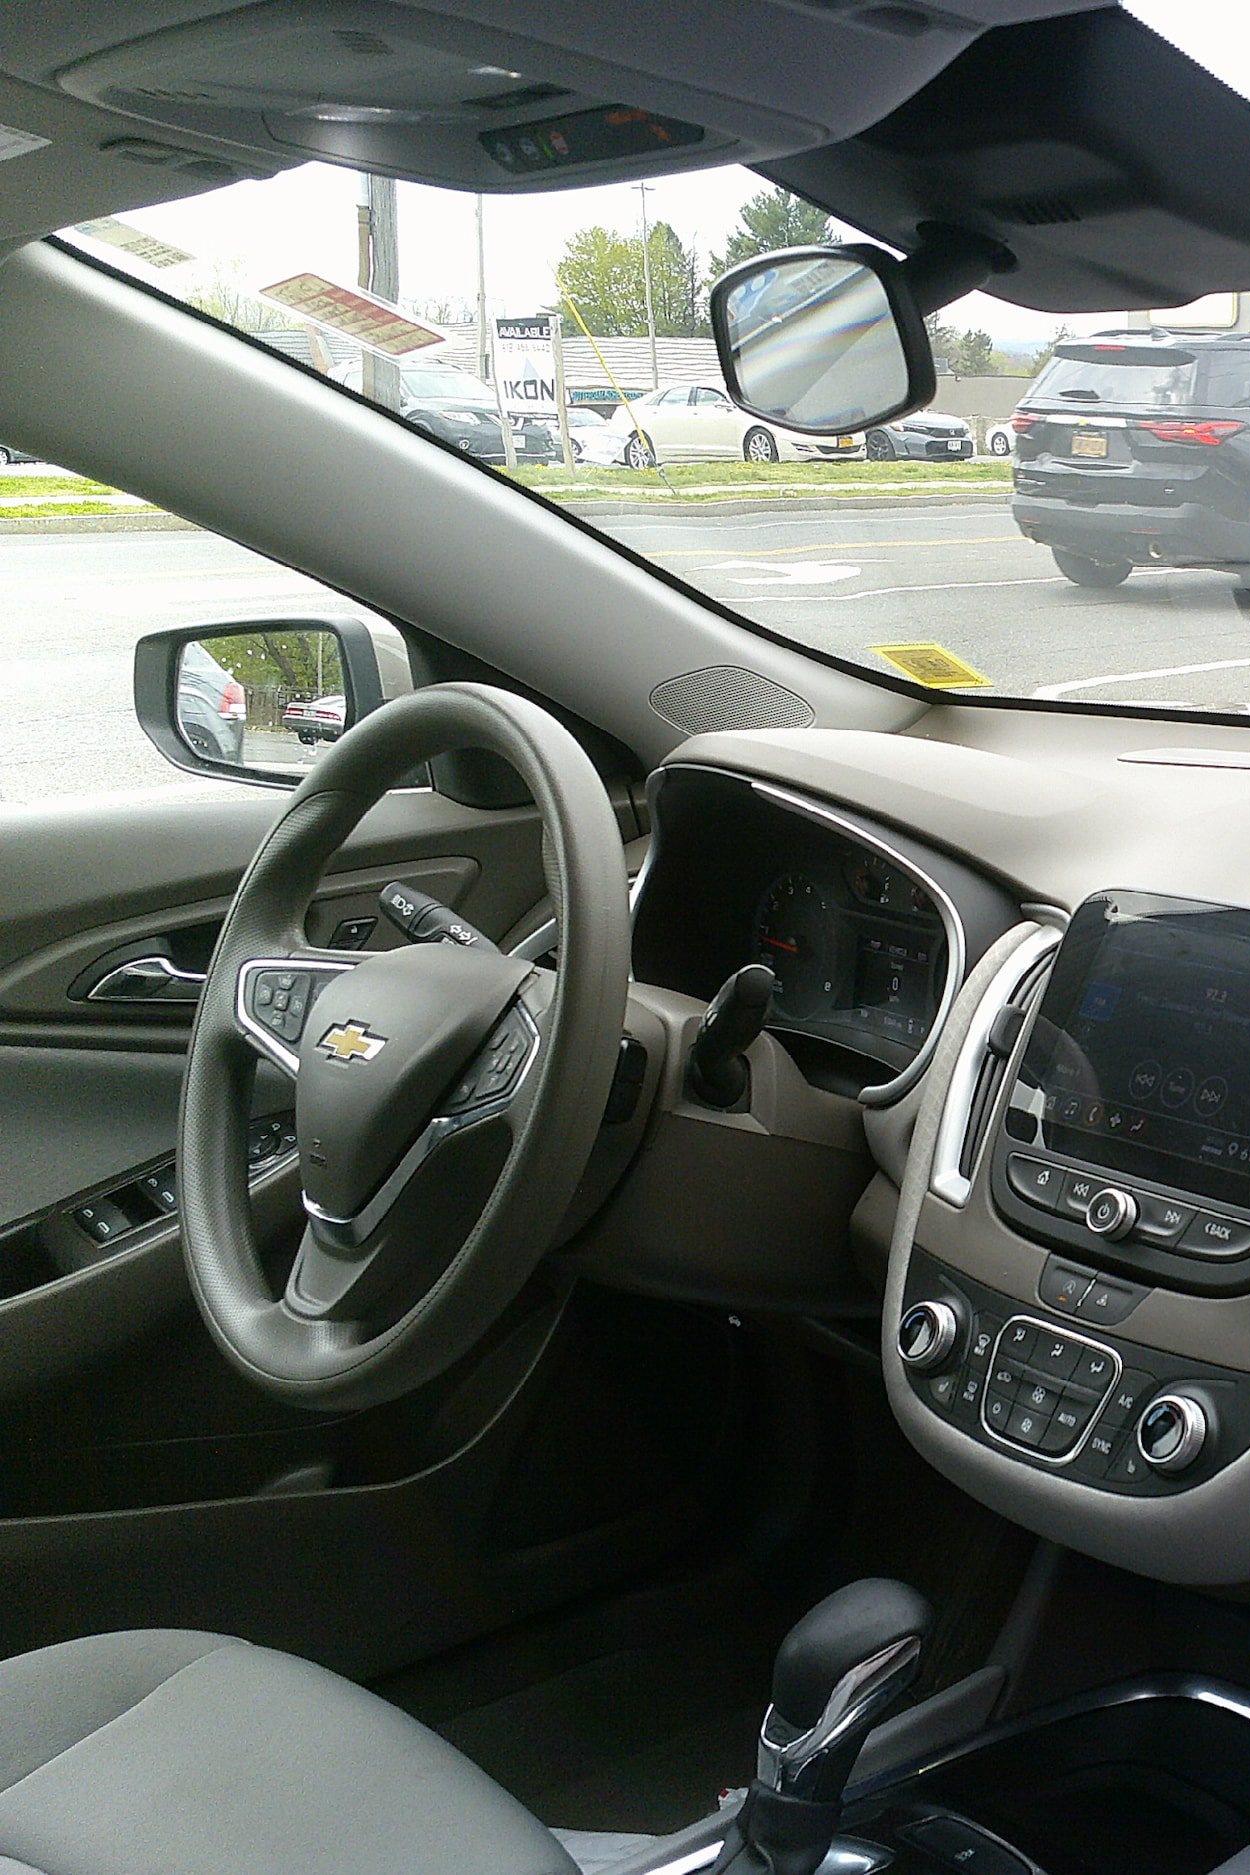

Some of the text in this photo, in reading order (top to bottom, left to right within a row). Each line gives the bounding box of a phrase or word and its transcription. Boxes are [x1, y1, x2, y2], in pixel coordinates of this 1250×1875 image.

[499, 326, 551, 338] AVAILABLE
[503, 378, 555, 401] IKON
[1210, 1223, 1232, 1240] BACK
[1117, 1393, 1134, 1409] A/C
[1057, 1412, 1077, 1428] AUTO
[1091, 1437, 1112, 1455] SYNC
